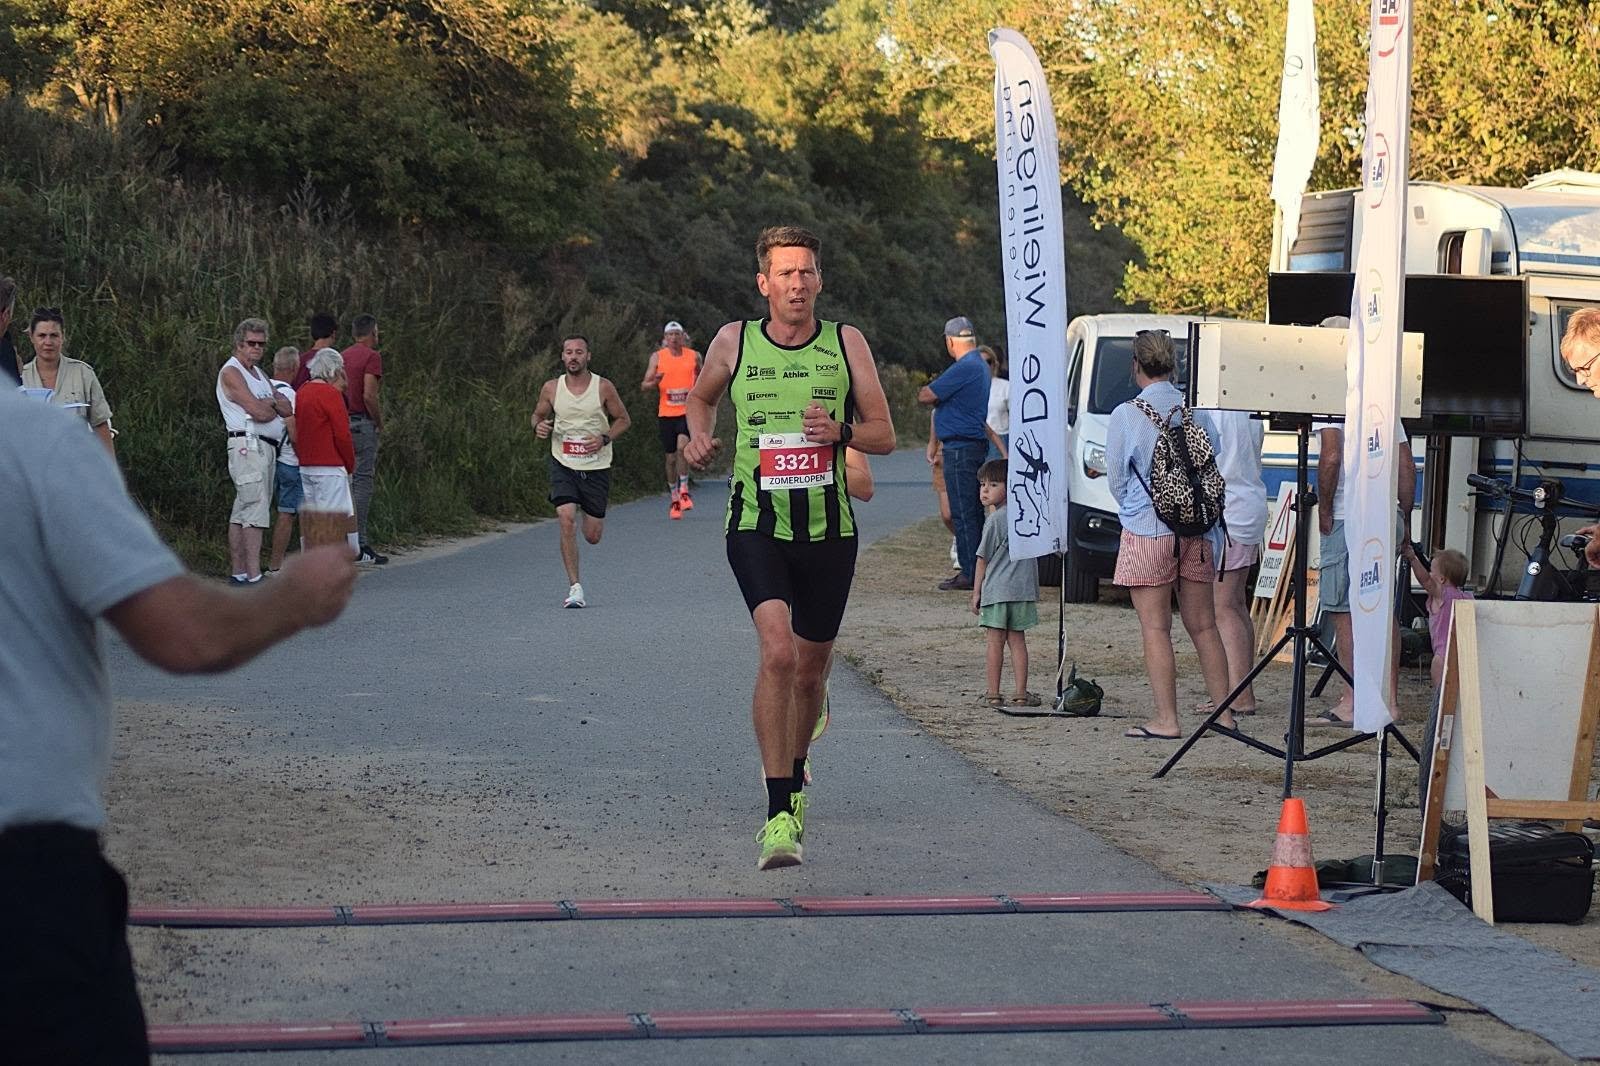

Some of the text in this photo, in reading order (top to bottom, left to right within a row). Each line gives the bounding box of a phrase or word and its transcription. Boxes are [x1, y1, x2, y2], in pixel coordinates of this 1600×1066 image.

[569, 444, 588, 453] 336
[774, 452, 819, 470] 3321
[769, 474, 826, 485] ZOMERLOPEN
